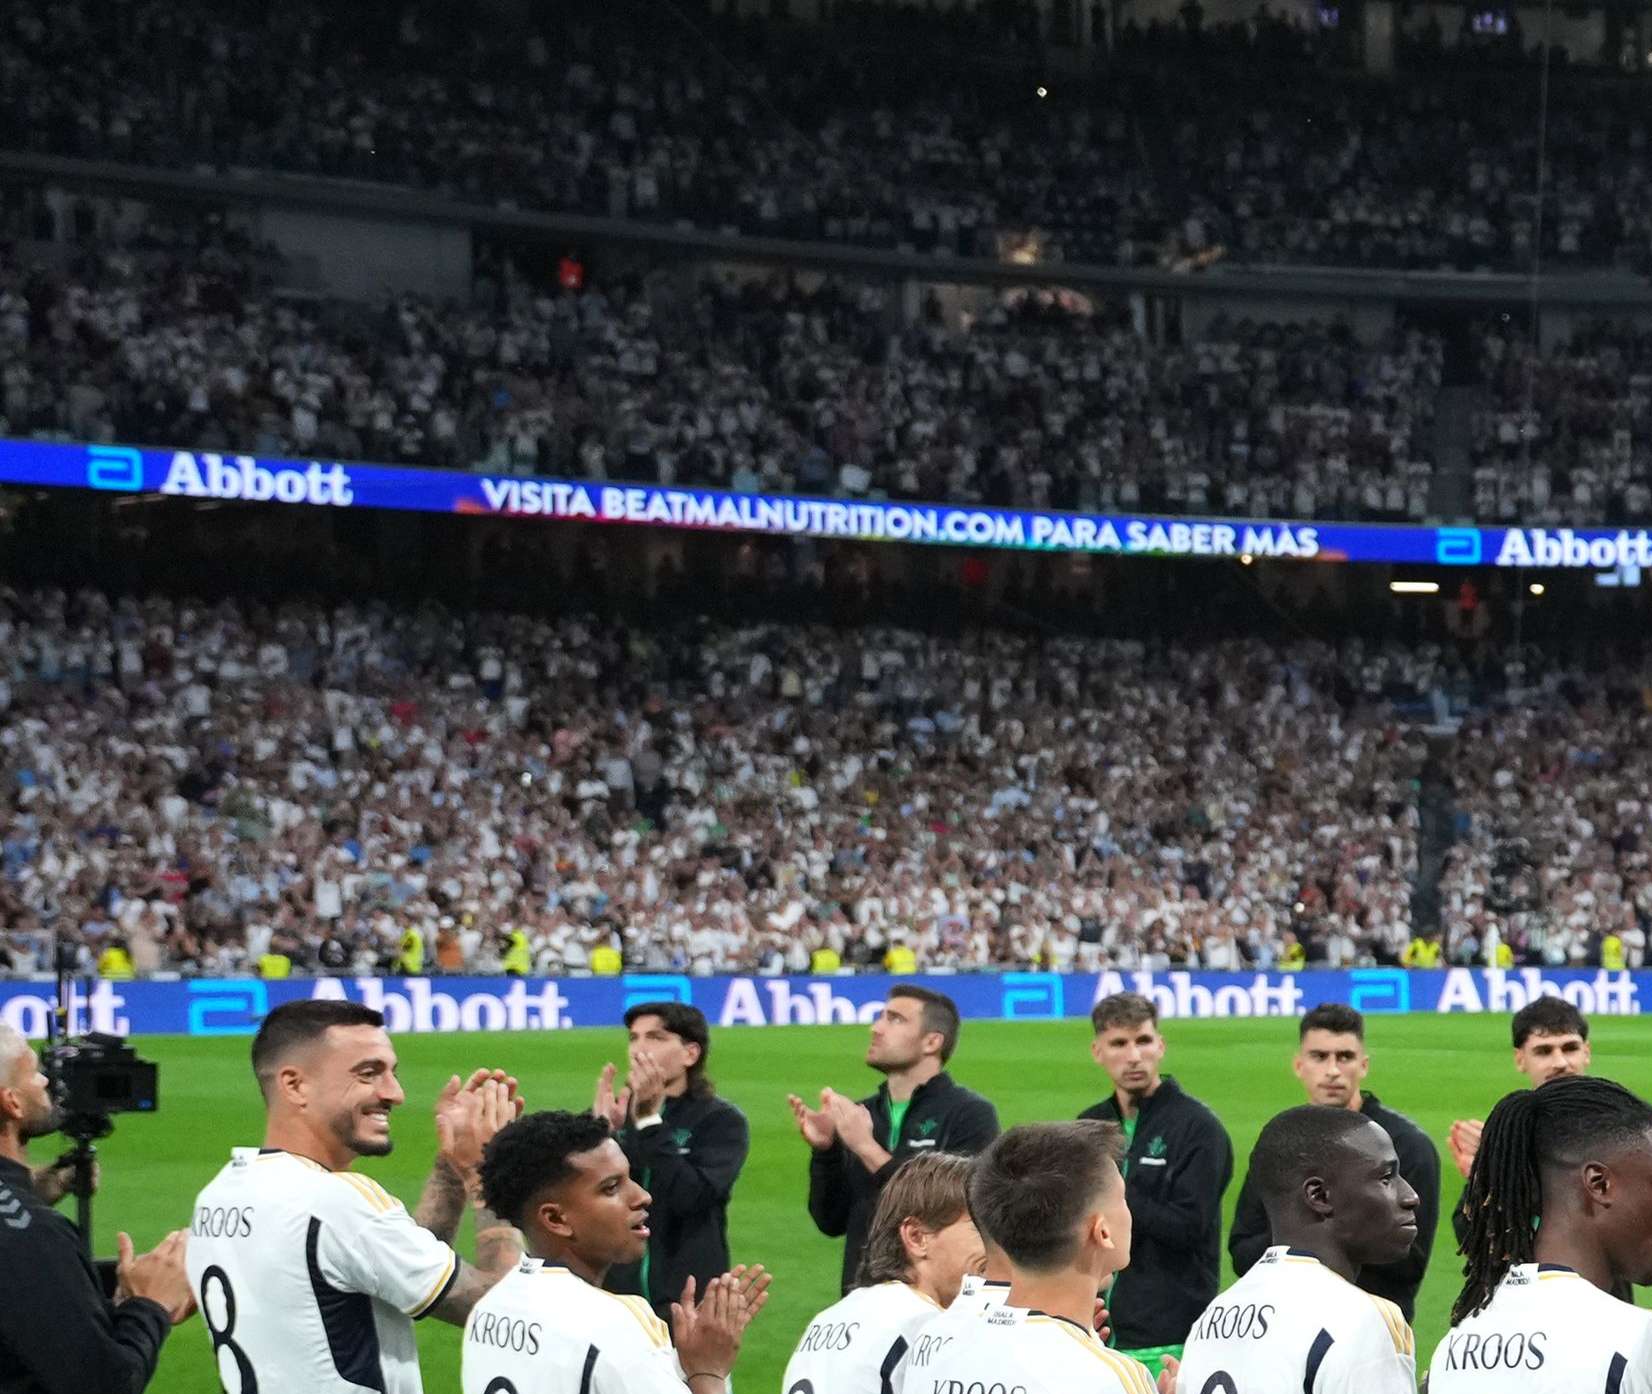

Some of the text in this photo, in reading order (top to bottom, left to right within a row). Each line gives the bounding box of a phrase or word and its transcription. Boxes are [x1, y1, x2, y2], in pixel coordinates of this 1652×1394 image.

[160, 452, 354, 506] Abbott
[481, 477, 1319, 558] VISITA BEATMALNUTRITION.COM PARA SABER MÁS
[2, 979, 130, 1039] ott
[719, 976, 888, 1027] Abbo
[1436, 967, 1642, 1016] Abbott
[469, 1310, 543, 1356] KROOS
[1445, 1331, 1548, 1371] KROOS
